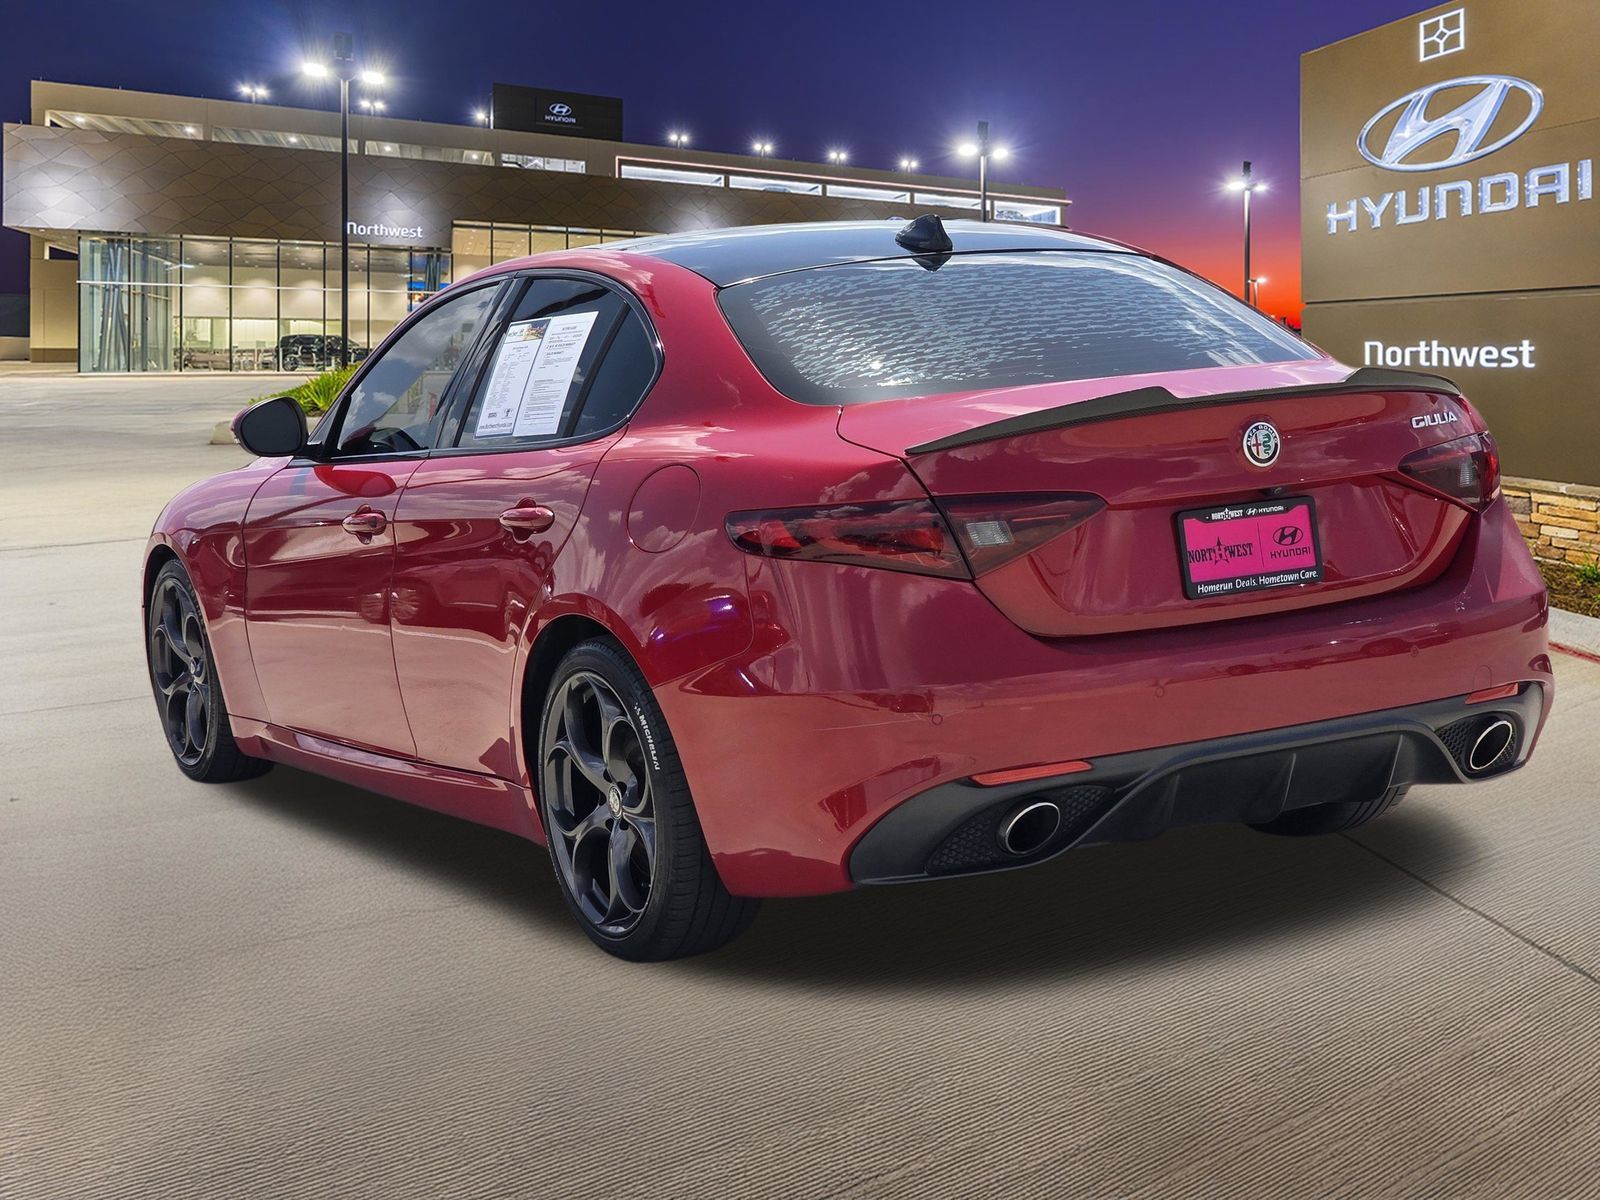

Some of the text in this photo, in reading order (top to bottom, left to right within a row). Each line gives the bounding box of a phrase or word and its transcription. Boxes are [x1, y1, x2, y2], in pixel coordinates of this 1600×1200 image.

[1326, 159, 1593, 235] HYUNDAI
[347, 221, 424, 239] Northwest
[1363, 339, 1536, 369] Northwest
[1411, 411, 1458, 429] GIULIA
[1258, 505, 1285, 514] HYUNDAI
[1270, 546, 1312, 560] HYUNDAI
[1197, 569, 1319, 594] Homerun Deals. Hometown Care.
[639, 714, 661, 770] MICHELIN
